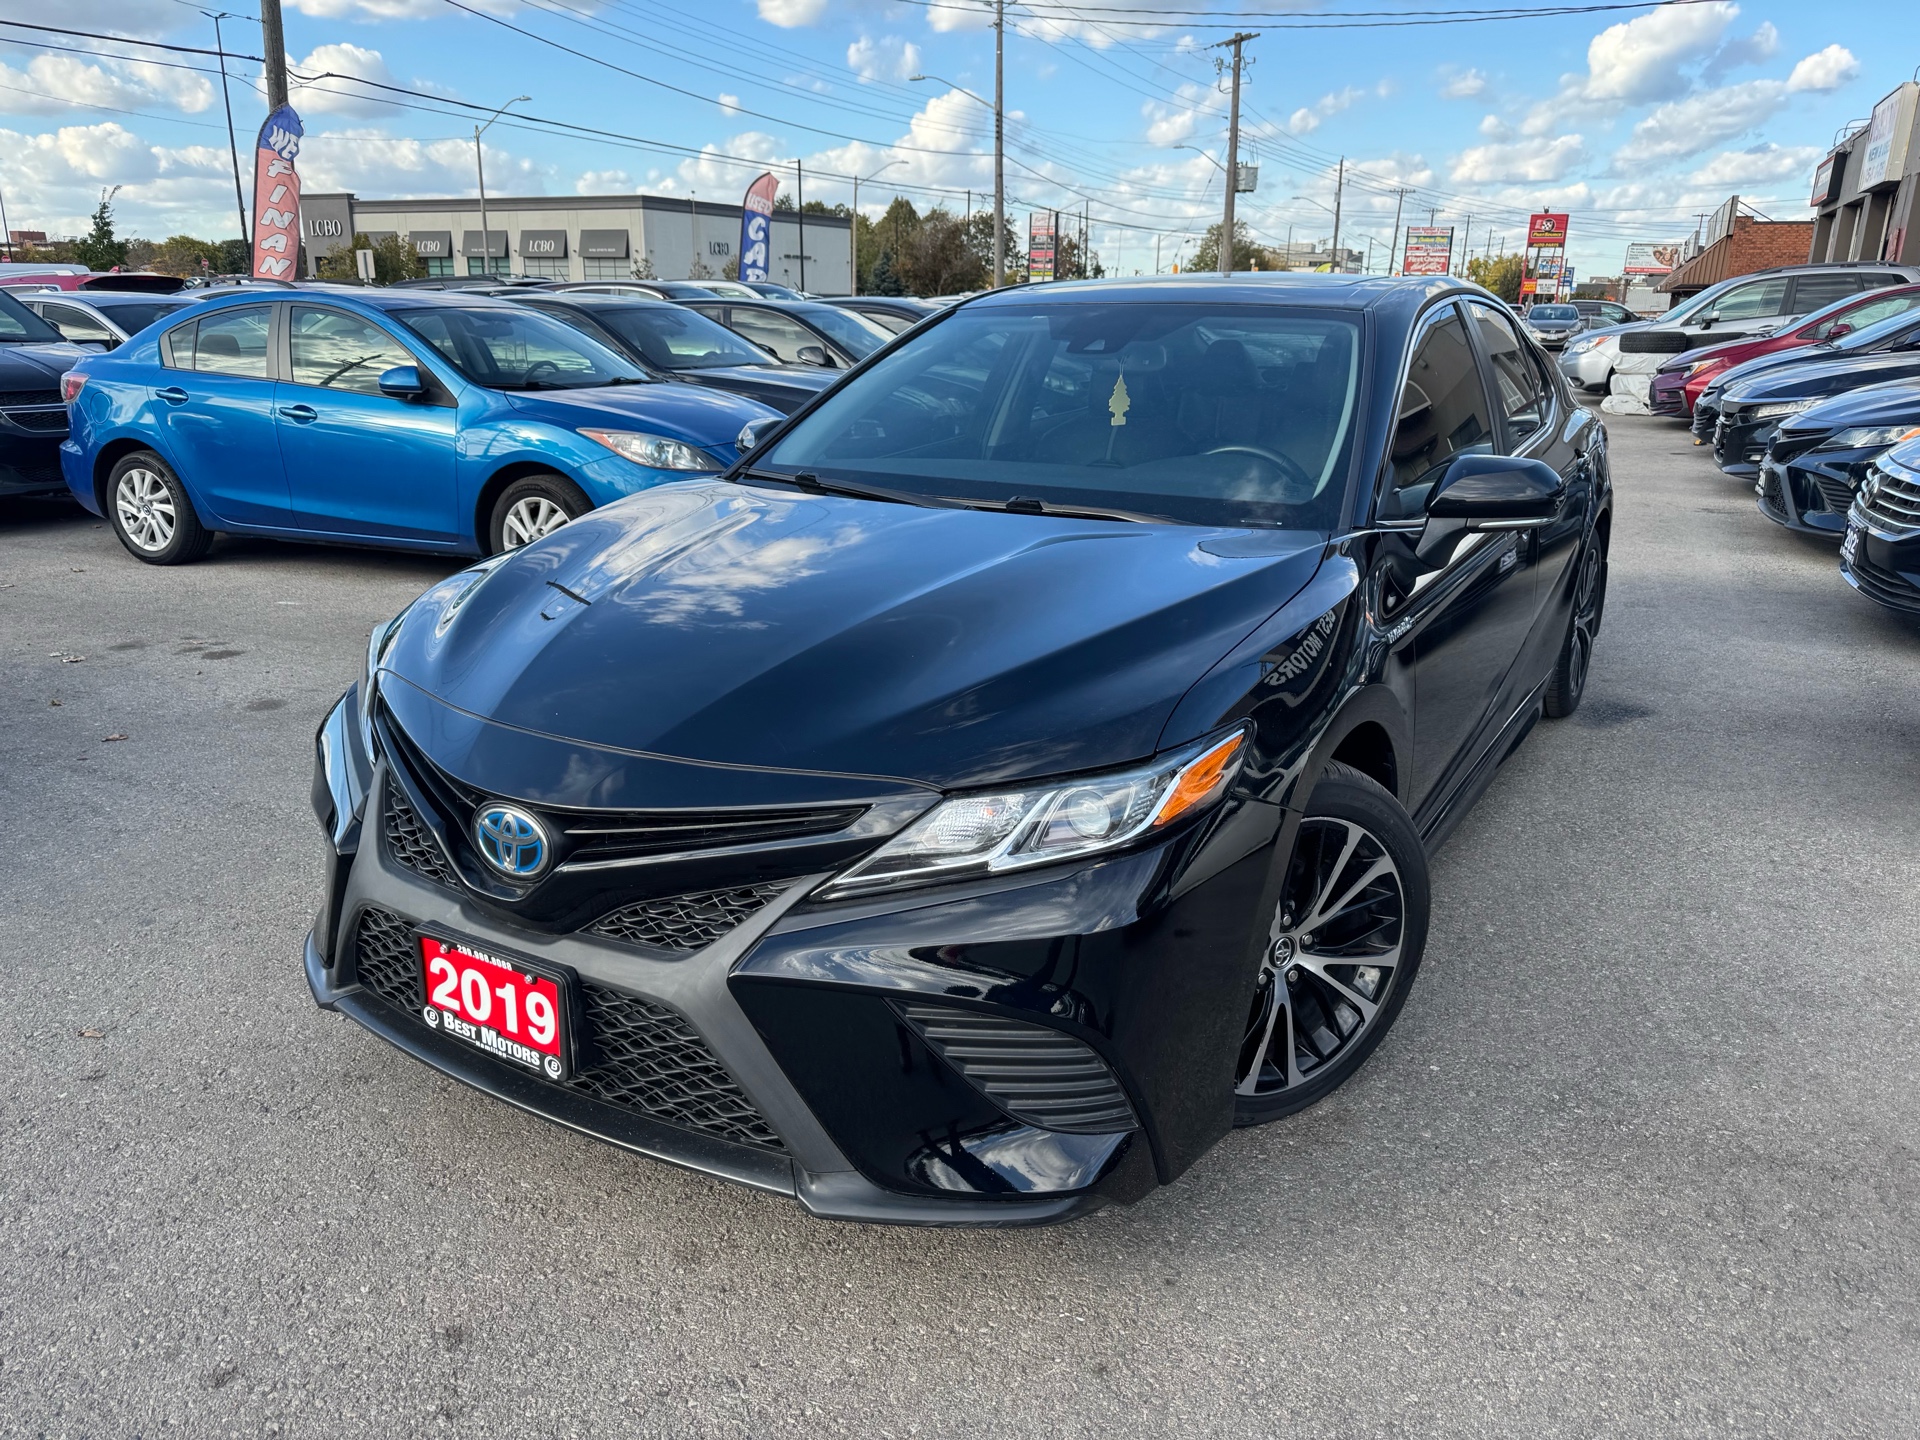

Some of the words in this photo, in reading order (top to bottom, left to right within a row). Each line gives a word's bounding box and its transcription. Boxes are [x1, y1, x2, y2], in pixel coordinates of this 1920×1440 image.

[268, 124, 300, 161] WE
[747, 193, 773, 215] USED
[309, 219, 342, 237] LCBO
[416, 240, 440, 253] LCBO
[528, 240, 555, 253] LCBO
[709, 241, 730, 256] LCBO
[429, 957, 556, 1046] 2019
[443, 1011, 478, 1039] BEST
[481, 1026, 541, 1066] MOTORS
